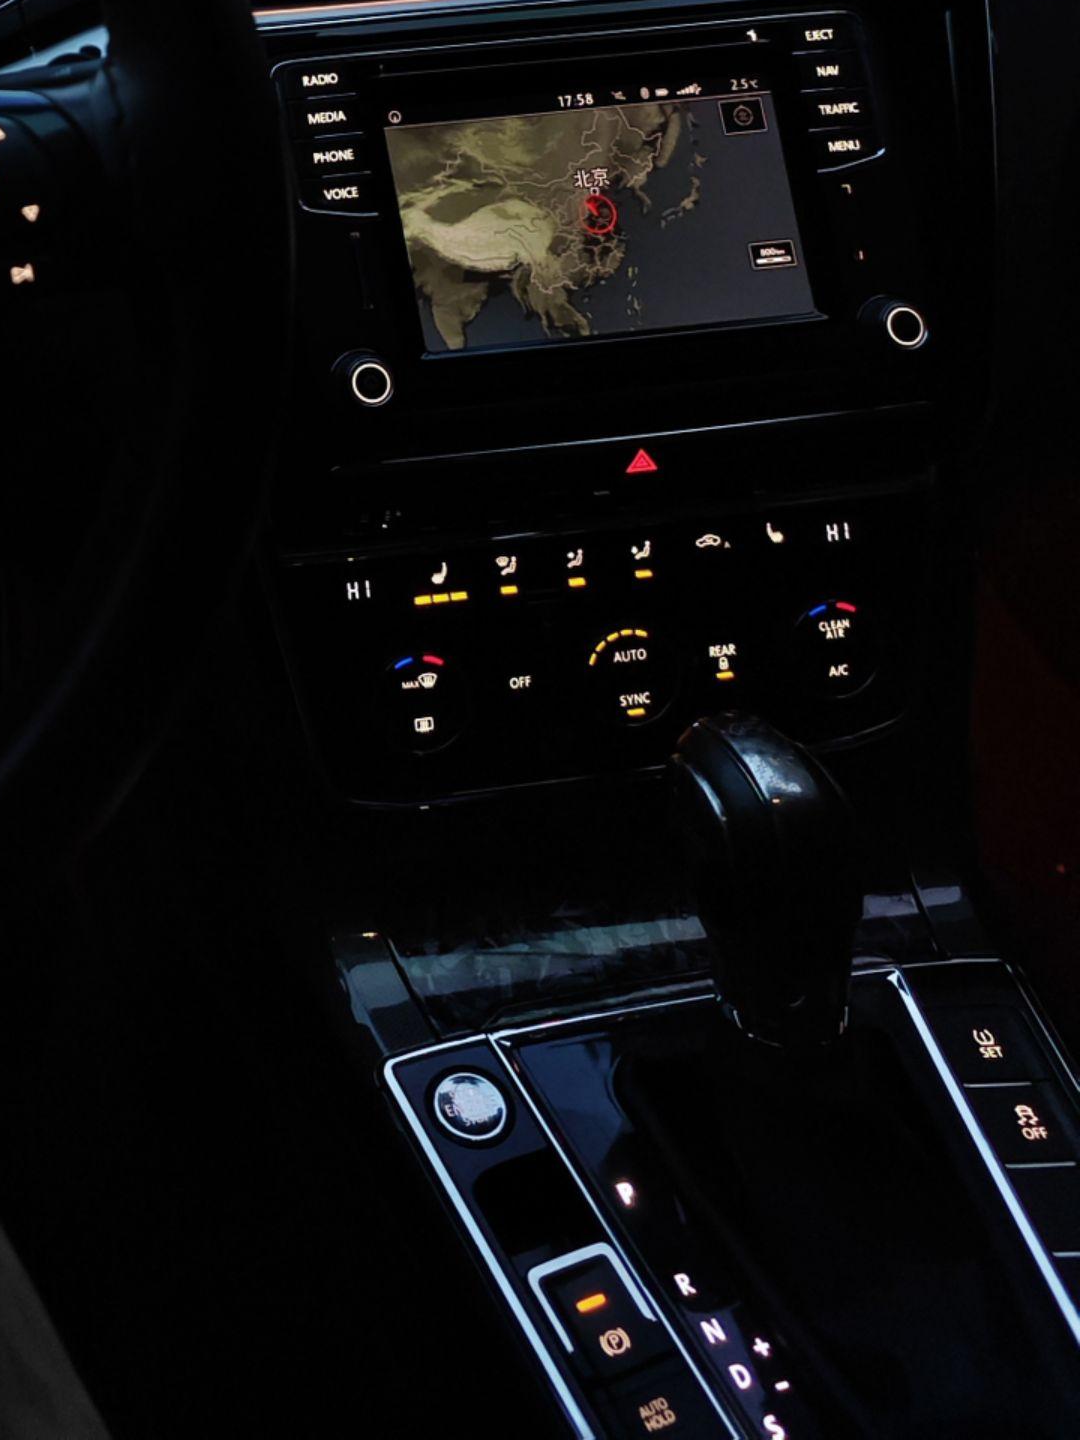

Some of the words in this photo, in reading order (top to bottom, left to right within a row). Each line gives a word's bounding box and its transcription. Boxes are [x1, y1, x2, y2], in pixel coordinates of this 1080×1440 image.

[805, 29, 833, 41] EJECT
[816, 65, 838, 76] NAV
[303, 73, 338, 86] RADIO
[558, 93, 593, 107] 17:58
[819, 102, 859, 114] TRAFFIC
[308, 111, 346, 124] MEDIA
[828, 140, 860, 151] MENU
[313, 149, 354, 163] PHONE
[574, 168, 610, 188] 北京
[324, 187, 359, 200] VOICE
[819, 619, 850, 633] CLEAN
[826, 628, 845, 639] AIR
[614, 649, 646, 662] AUTO
[709, 644, 736, 657] REAR
[829, 664, 848, 676] A/C
[402, 680, 420, 688] MAX
[510, 676, 530, 689] OFF
[620, 692, 650, 706] SYNC
[979, 1047, 1003, 1058] SET
[1022, 1127, 1048, 1140] OFF
[615, 1181, 634, 1205] P
[674, 1273, 696, 1296] R
[700, 1318, 726, 1344] N
[728, 1364, 752, 1389] D
[639, 1397, 669, 1420] AUTO
[643, 1410, 676, 1432] HOLD
[763, 1415, 785, 1440] S
